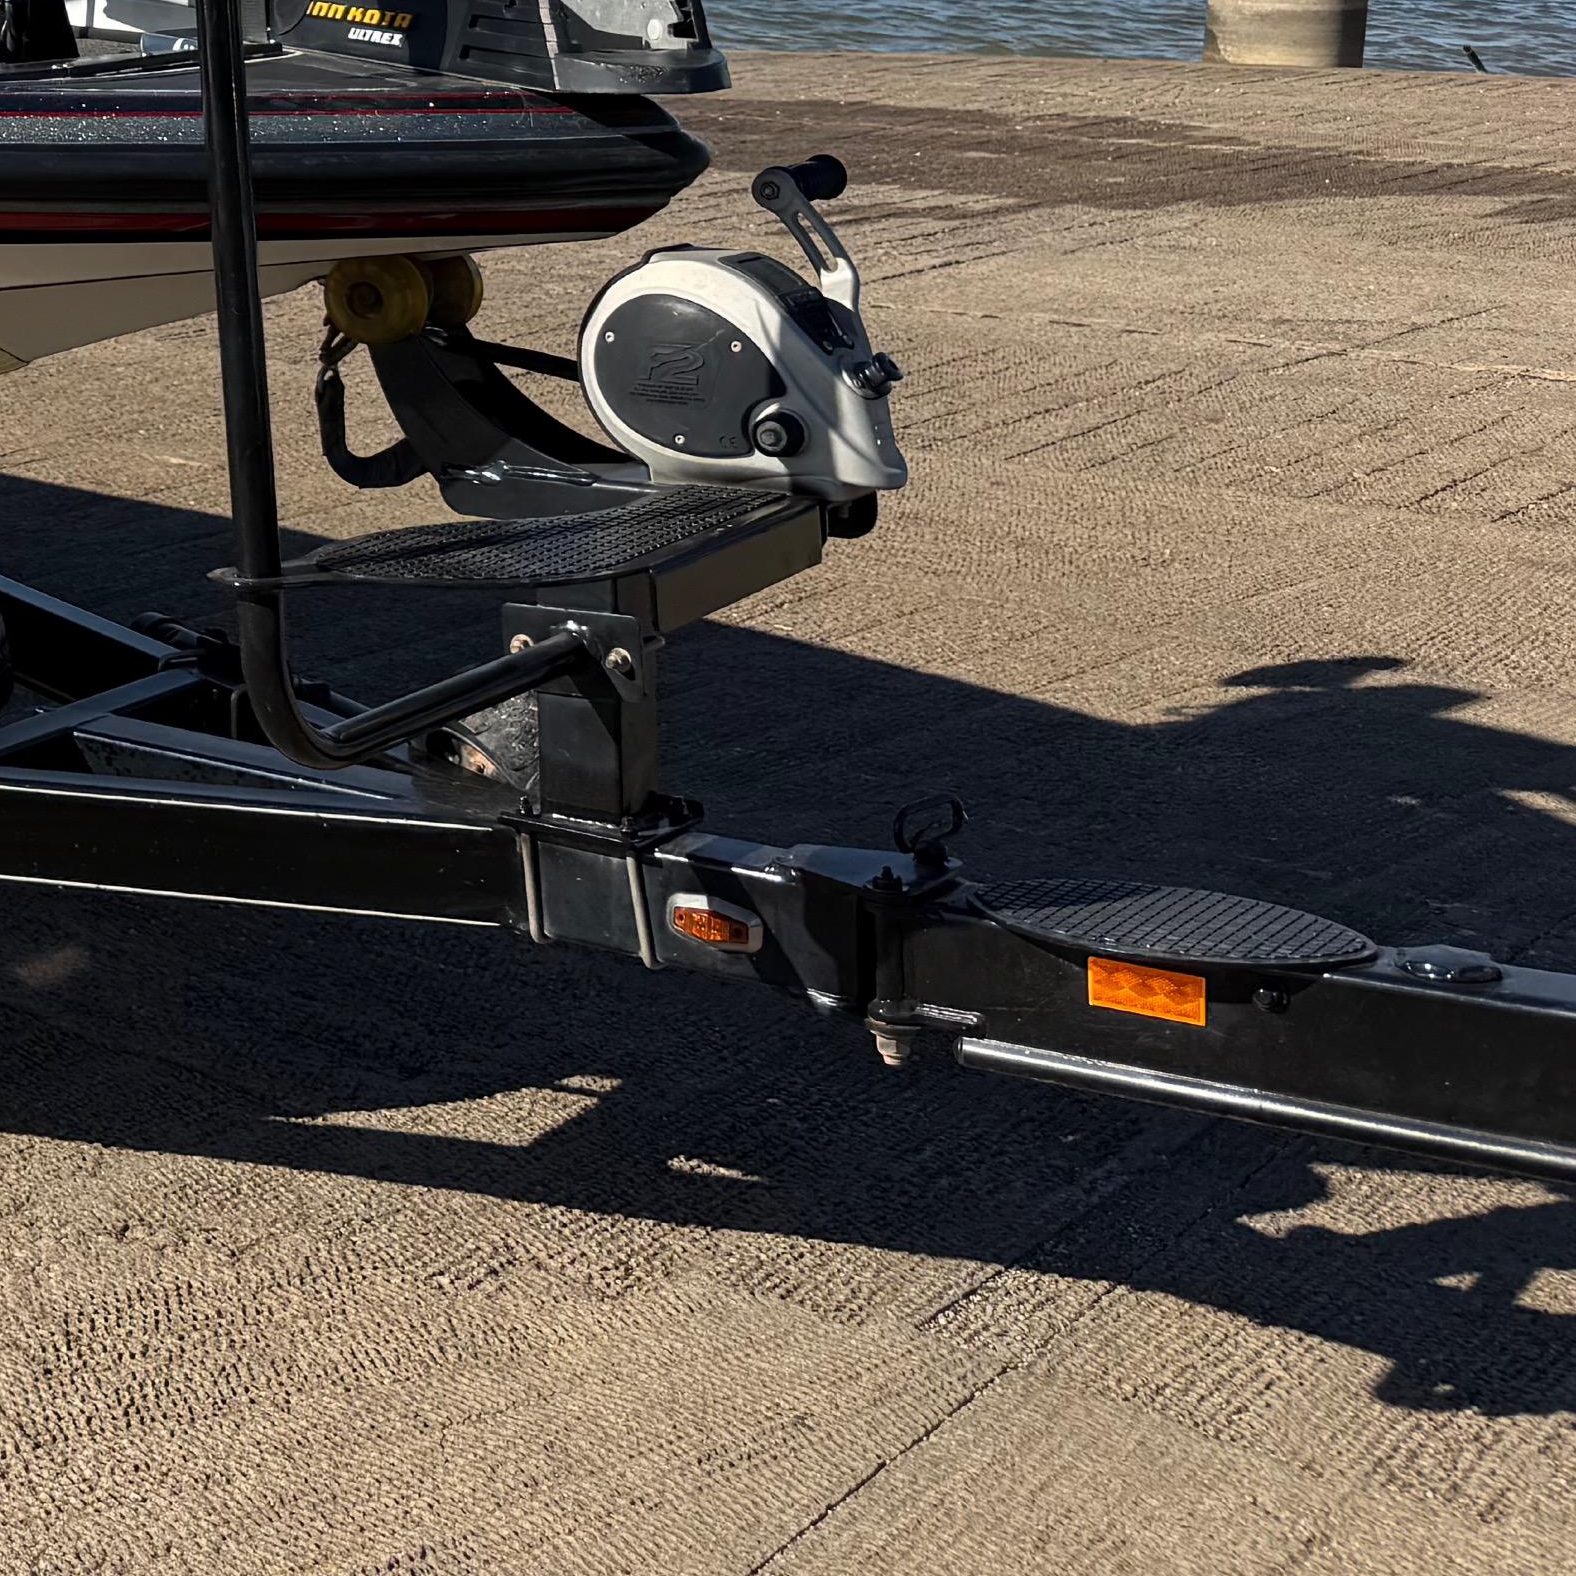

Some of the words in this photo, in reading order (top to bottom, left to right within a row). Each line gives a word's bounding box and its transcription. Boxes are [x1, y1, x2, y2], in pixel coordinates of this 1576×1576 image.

[306, 0, 347, 20] INN
[347, 6, 414, 28] KOTA
[348, 27, 403, 46] ULTREX
